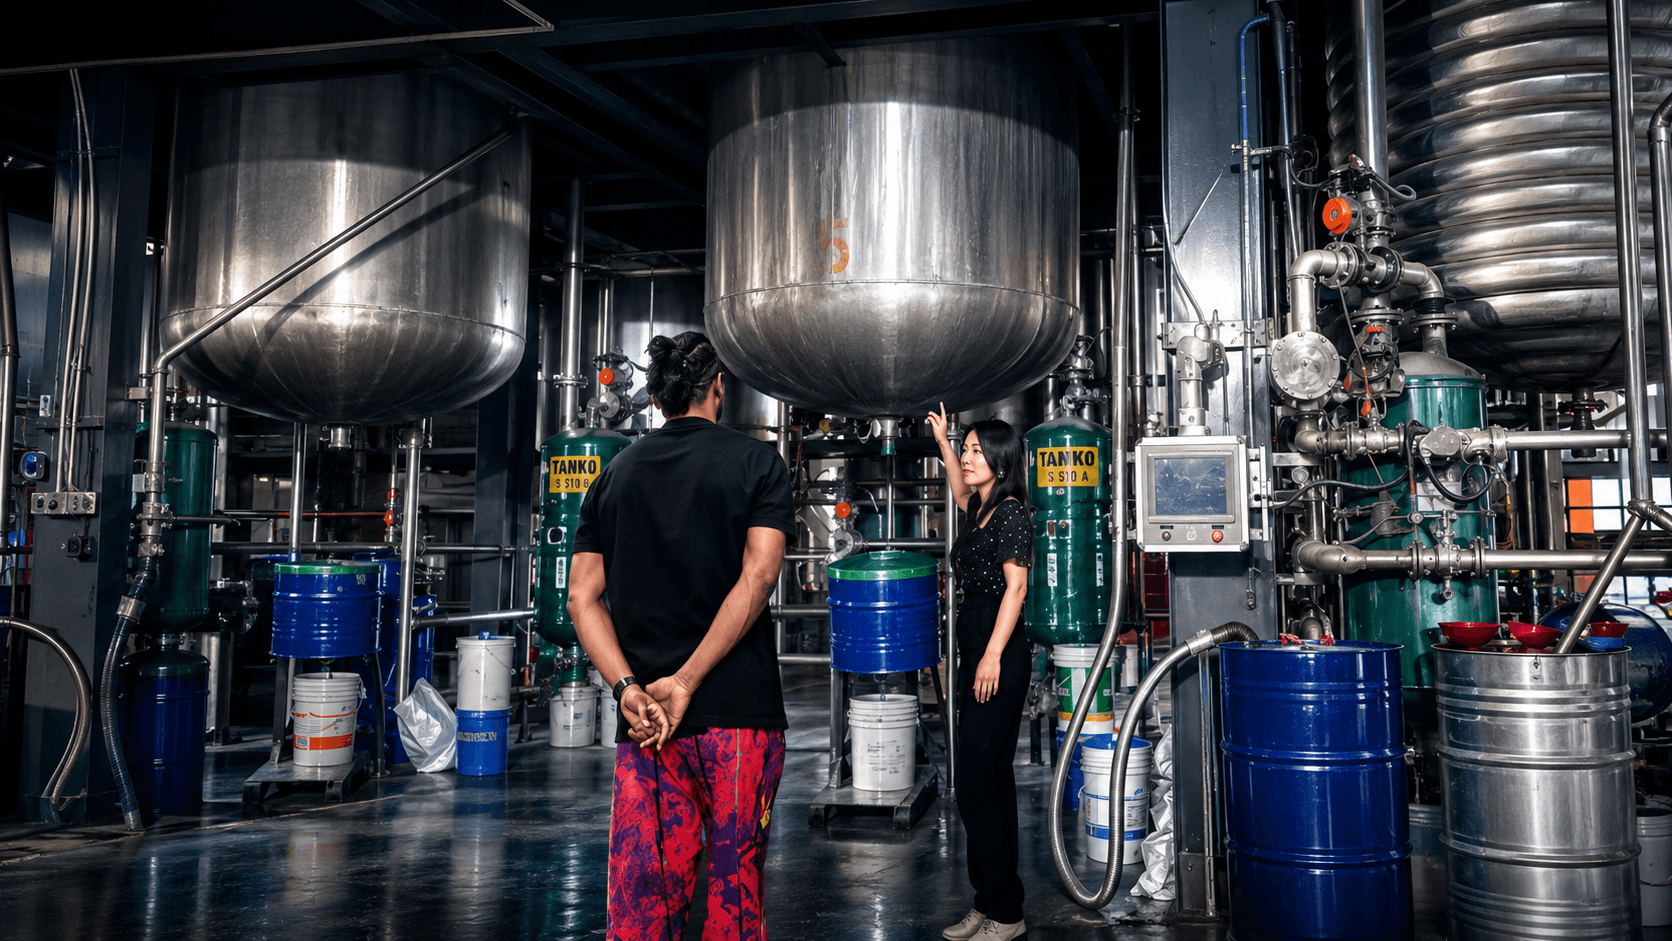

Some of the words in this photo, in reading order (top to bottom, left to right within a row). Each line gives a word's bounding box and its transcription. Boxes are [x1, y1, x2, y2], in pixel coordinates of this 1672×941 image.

[819, 218, 850, 274] 5
[1039, 451, 1095, 467] TANKO
[552, 460, 597, 475] TANKO
[556, 478, 561, 489] S
[1048, 471, 1054, 482] S
[1058, 471, 1077, 482] S10
[1082, 471, 1089, 482] A
